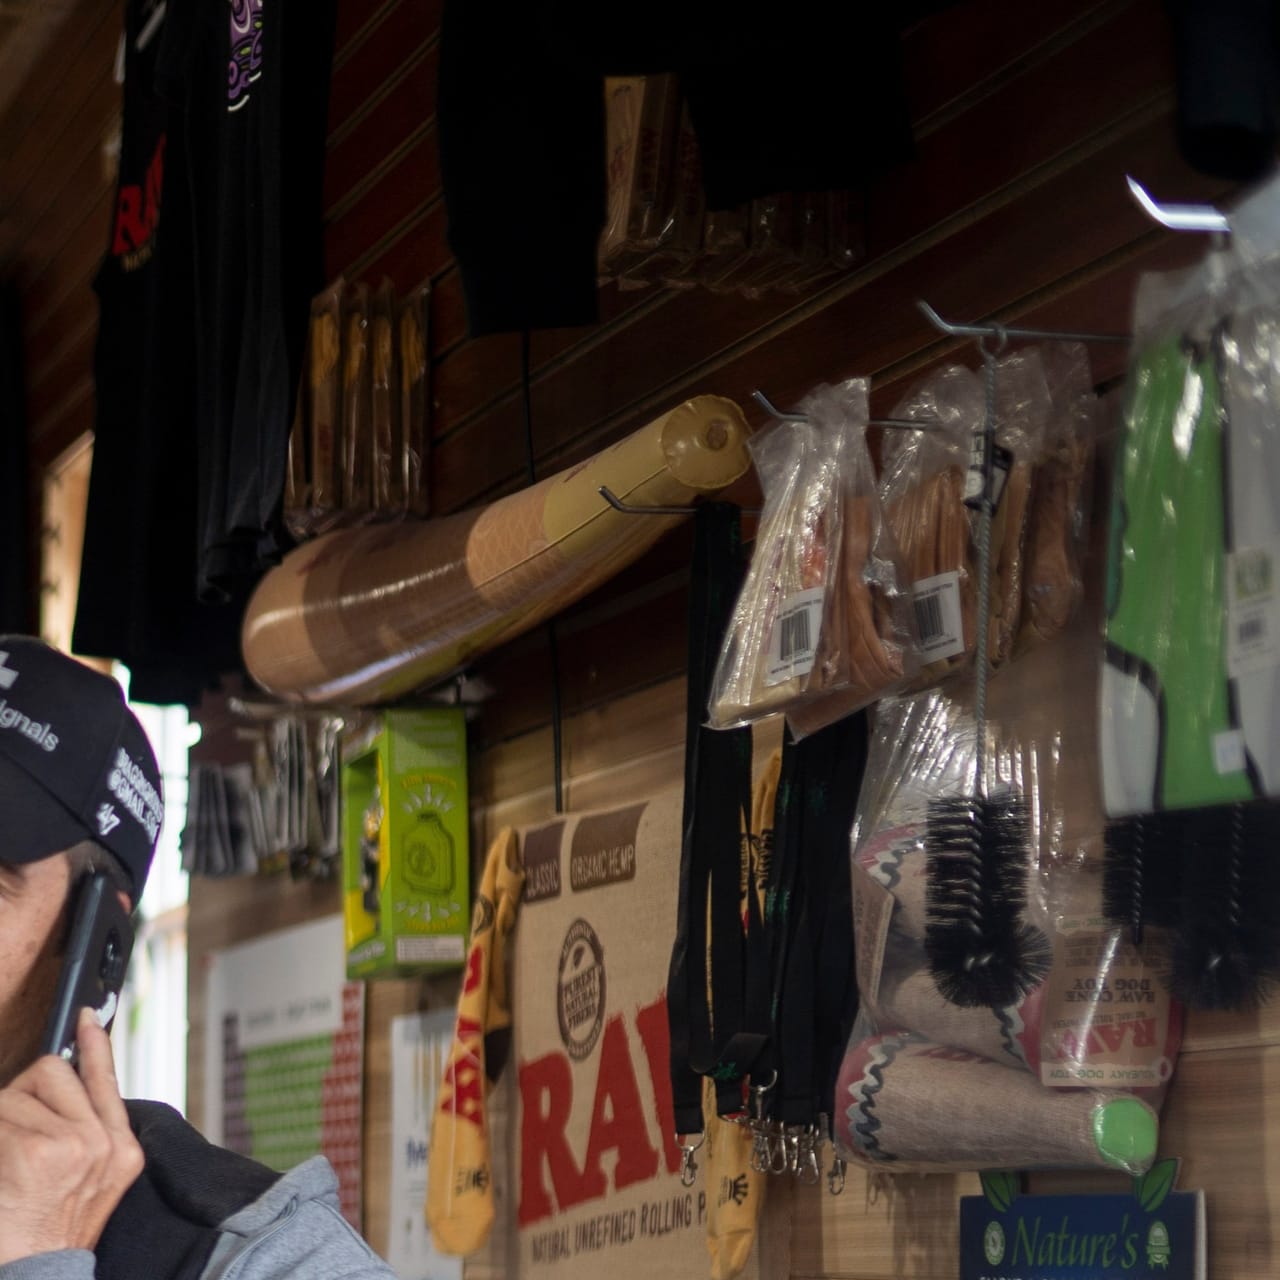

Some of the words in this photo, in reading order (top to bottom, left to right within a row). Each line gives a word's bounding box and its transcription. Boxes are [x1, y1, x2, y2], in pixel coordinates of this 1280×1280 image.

[608, 844, 635, 873] HEMP
[532, 1226, 572, 1263] NATURAL
[574, 1211, 637, 1252] UNREFINED
[639, 1201, 695, 1243] ROLLING
[1010, 1213, 1139, 1271] Nature's
